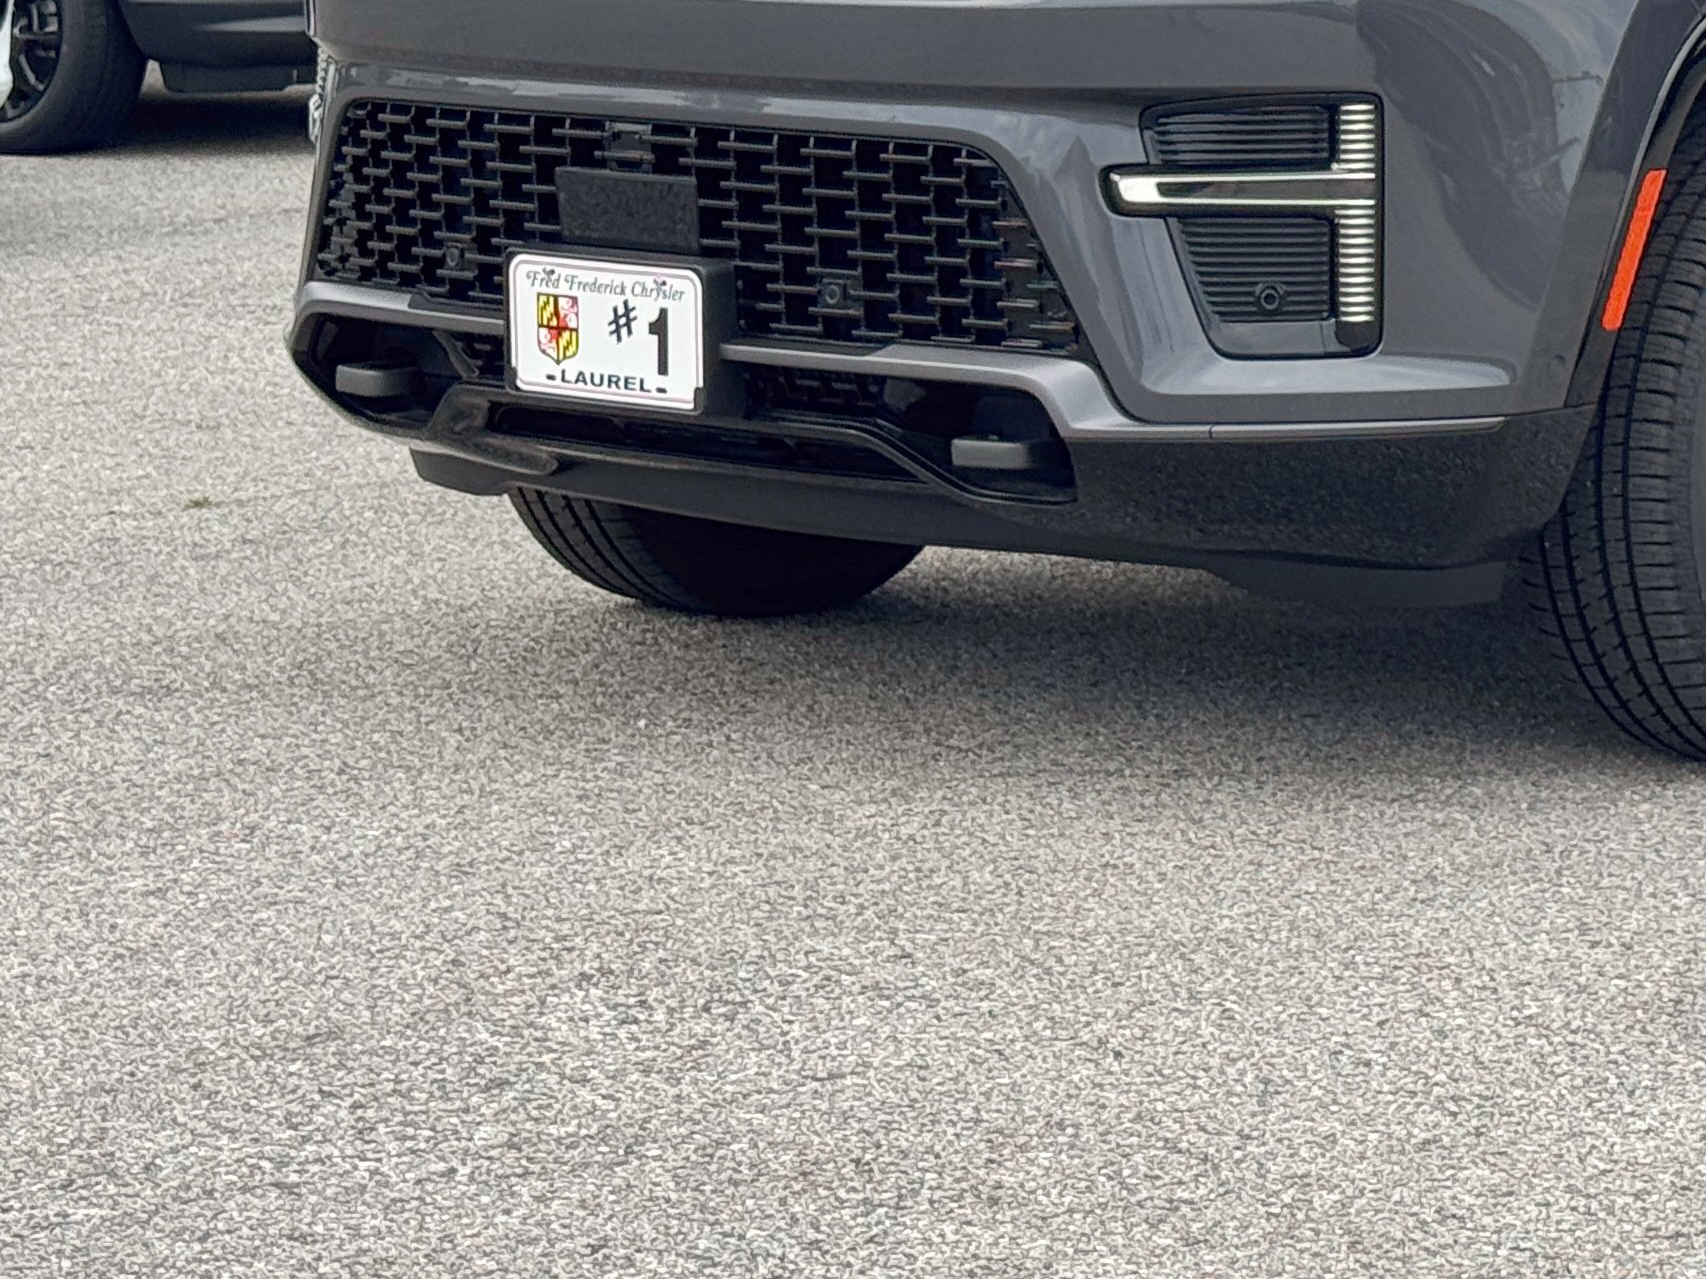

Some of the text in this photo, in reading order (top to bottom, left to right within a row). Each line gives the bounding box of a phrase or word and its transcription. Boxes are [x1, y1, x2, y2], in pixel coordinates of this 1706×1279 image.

[526, 270, 685, 301] Fred Frederick Chrysler
[560, 368, 652, 393] LAUREL
